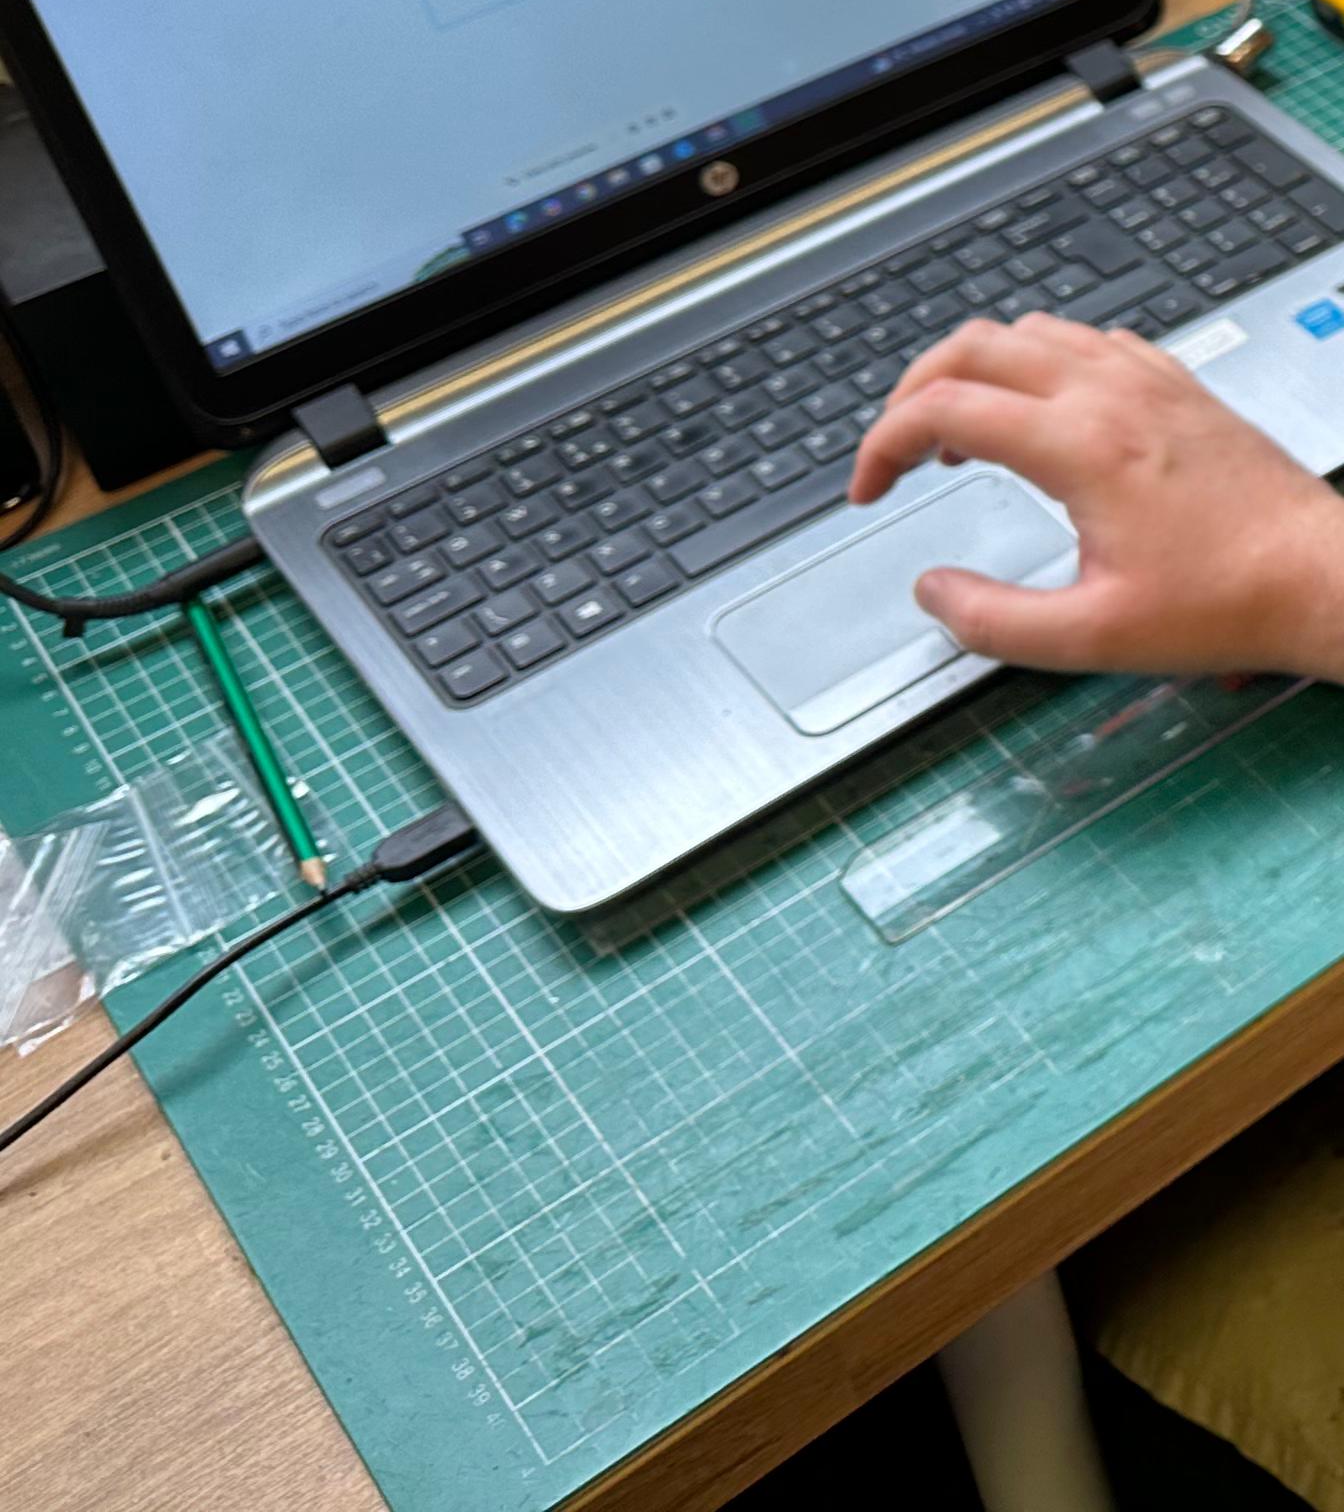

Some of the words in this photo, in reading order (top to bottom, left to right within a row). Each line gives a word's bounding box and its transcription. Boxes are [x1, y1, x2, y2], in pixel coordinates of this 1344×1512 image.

[288, 1094, 311, 1113] 27
[301, 1116, 325, 1137] 28
[315, 1139, 339, 1159] 29
[330, 1161, 354, 1183] 30
[344, 1187, 366, 1206] 31
[360, 1209, 382, 1230] 32
[374, 1232, 397, 1254] 33
[388, 1256, 411, 1278] 34
[403, 1281, 427, 1304] 35
[436, 1331, 459, 1351] 37
[452, 1357, 476, 1381] 38
[466, 1383, 491, 1407] 39
